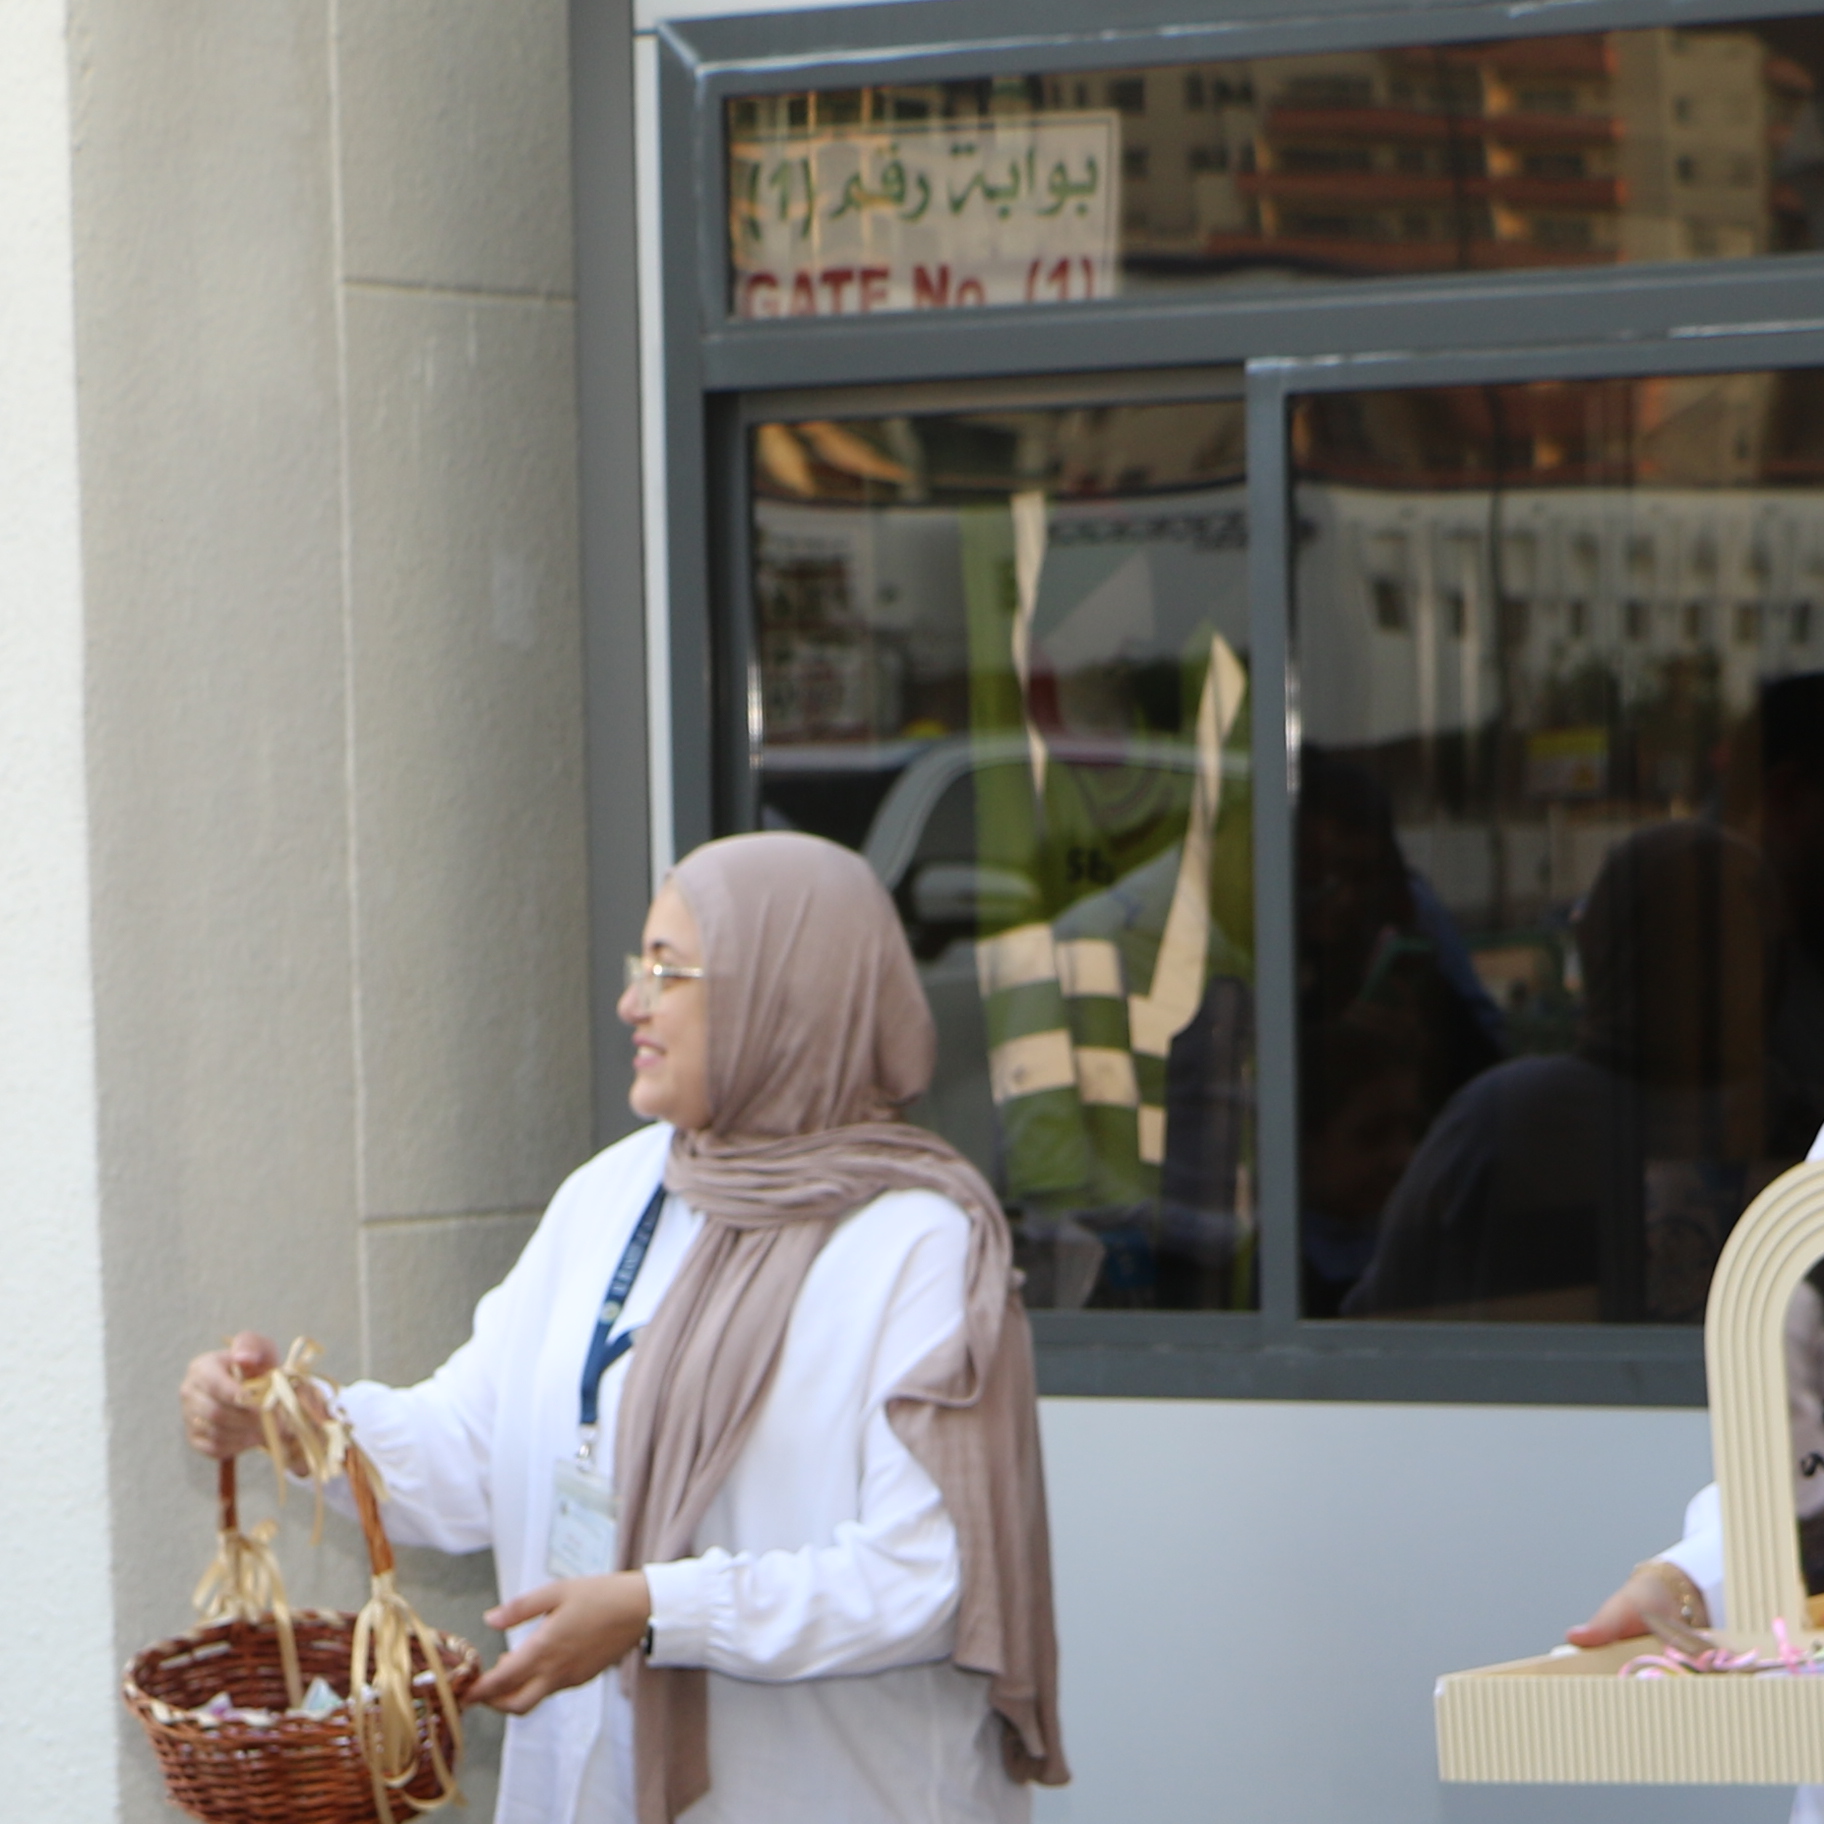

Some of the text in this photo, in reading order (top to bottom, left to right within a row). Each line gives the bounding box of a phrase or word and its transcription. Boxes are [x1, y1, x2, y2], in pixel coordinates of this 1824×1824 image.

[828, 142, 931, 222] رقم
[947, 140, 1100, 222] بوابة
[744, 265, 890, 320] GATE
